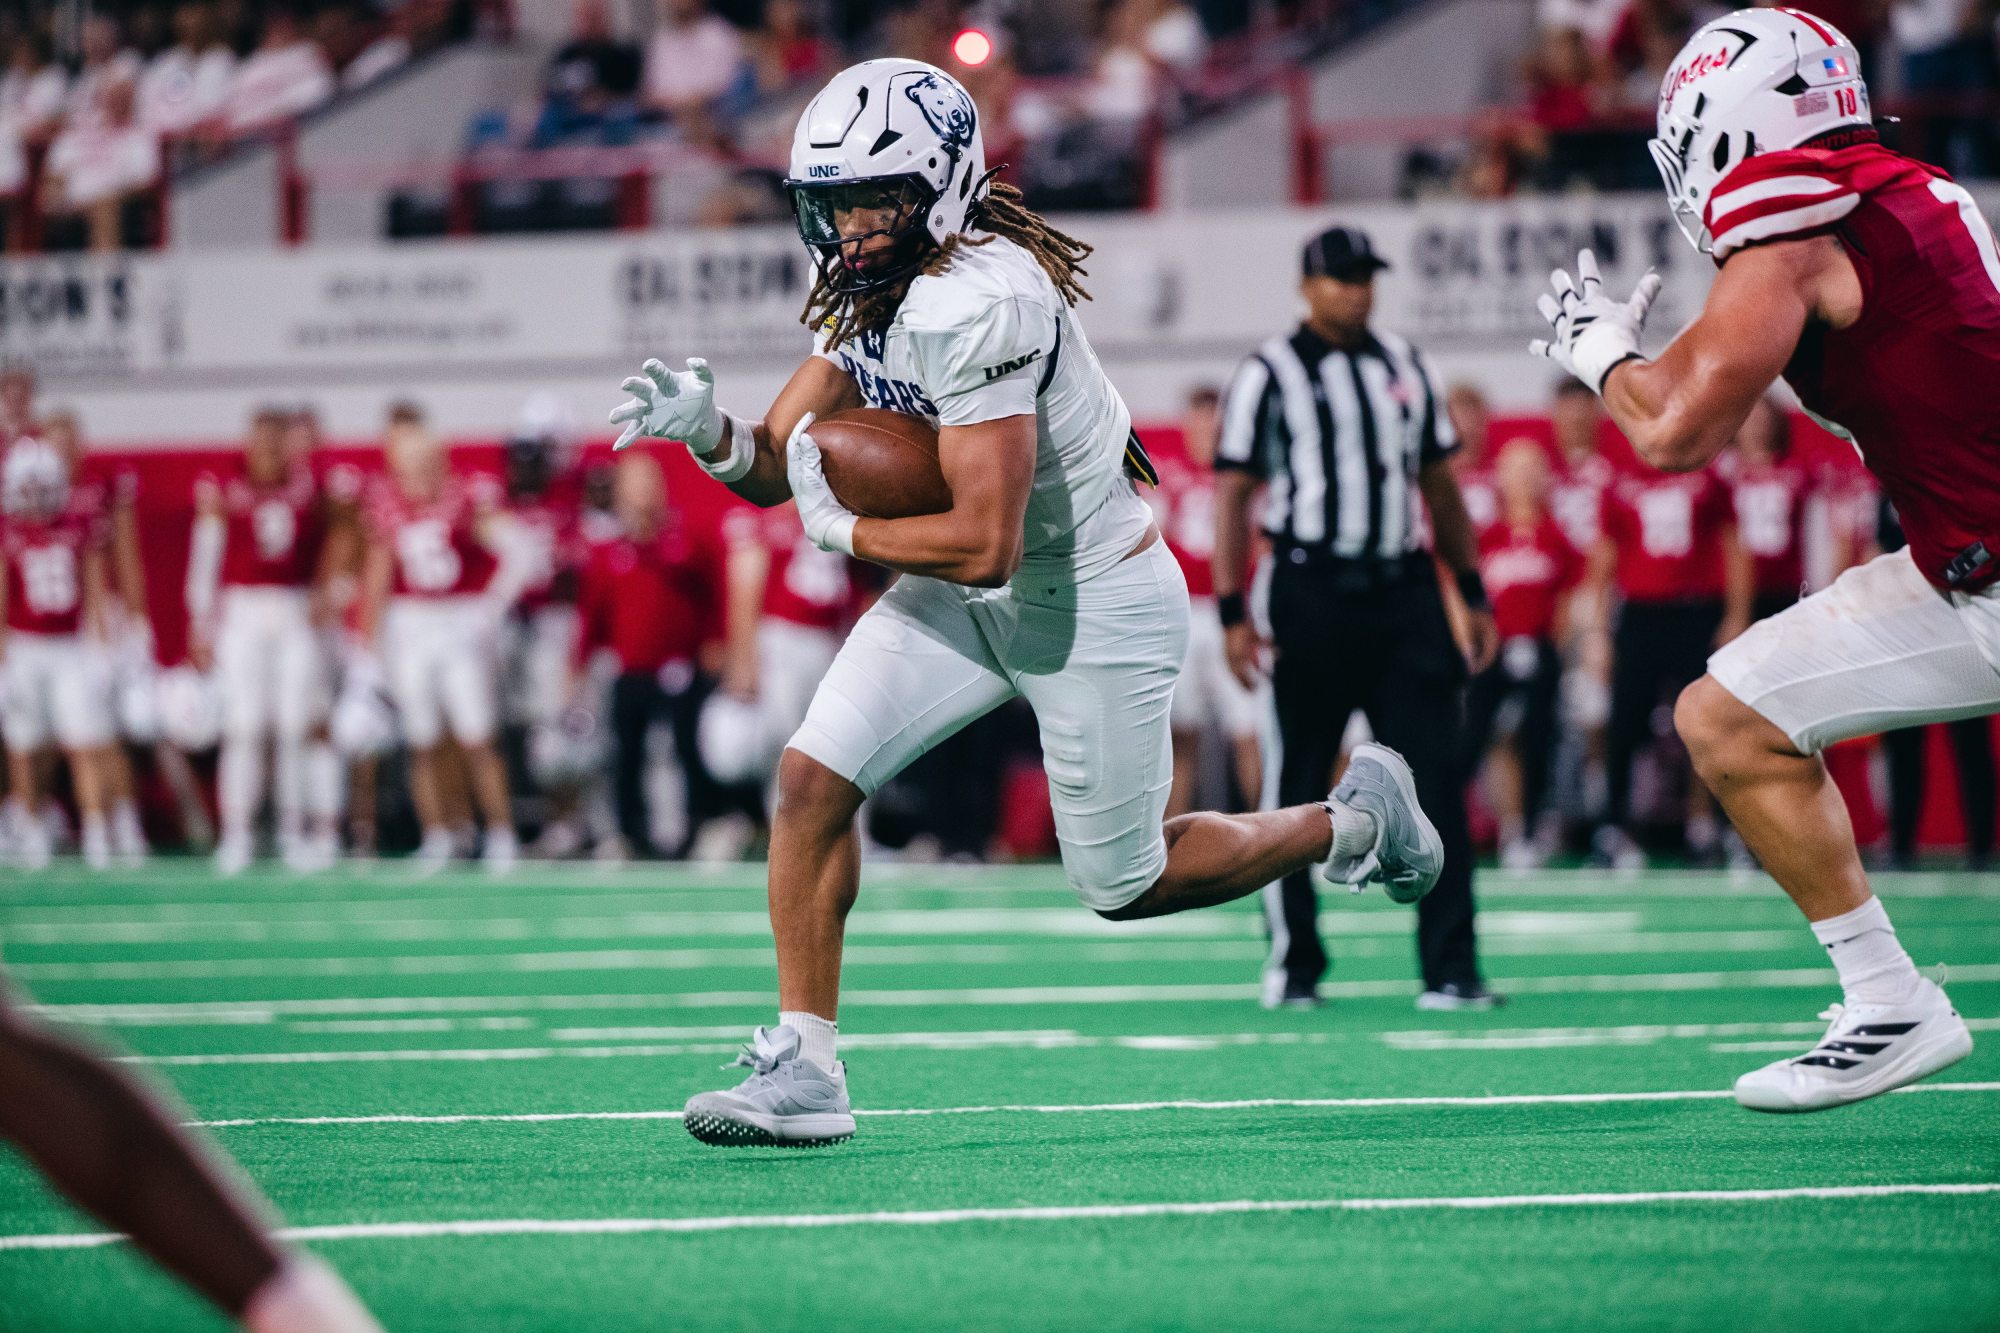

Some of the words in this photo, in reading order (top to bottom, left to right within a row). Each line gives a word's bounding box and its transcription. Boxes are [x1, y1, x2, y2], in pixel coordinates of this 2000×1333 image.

[1834, 87, 1857, 118] 10
[808, 165, 840, 178] UNC
[983, 348, 1043, 381] UNC
